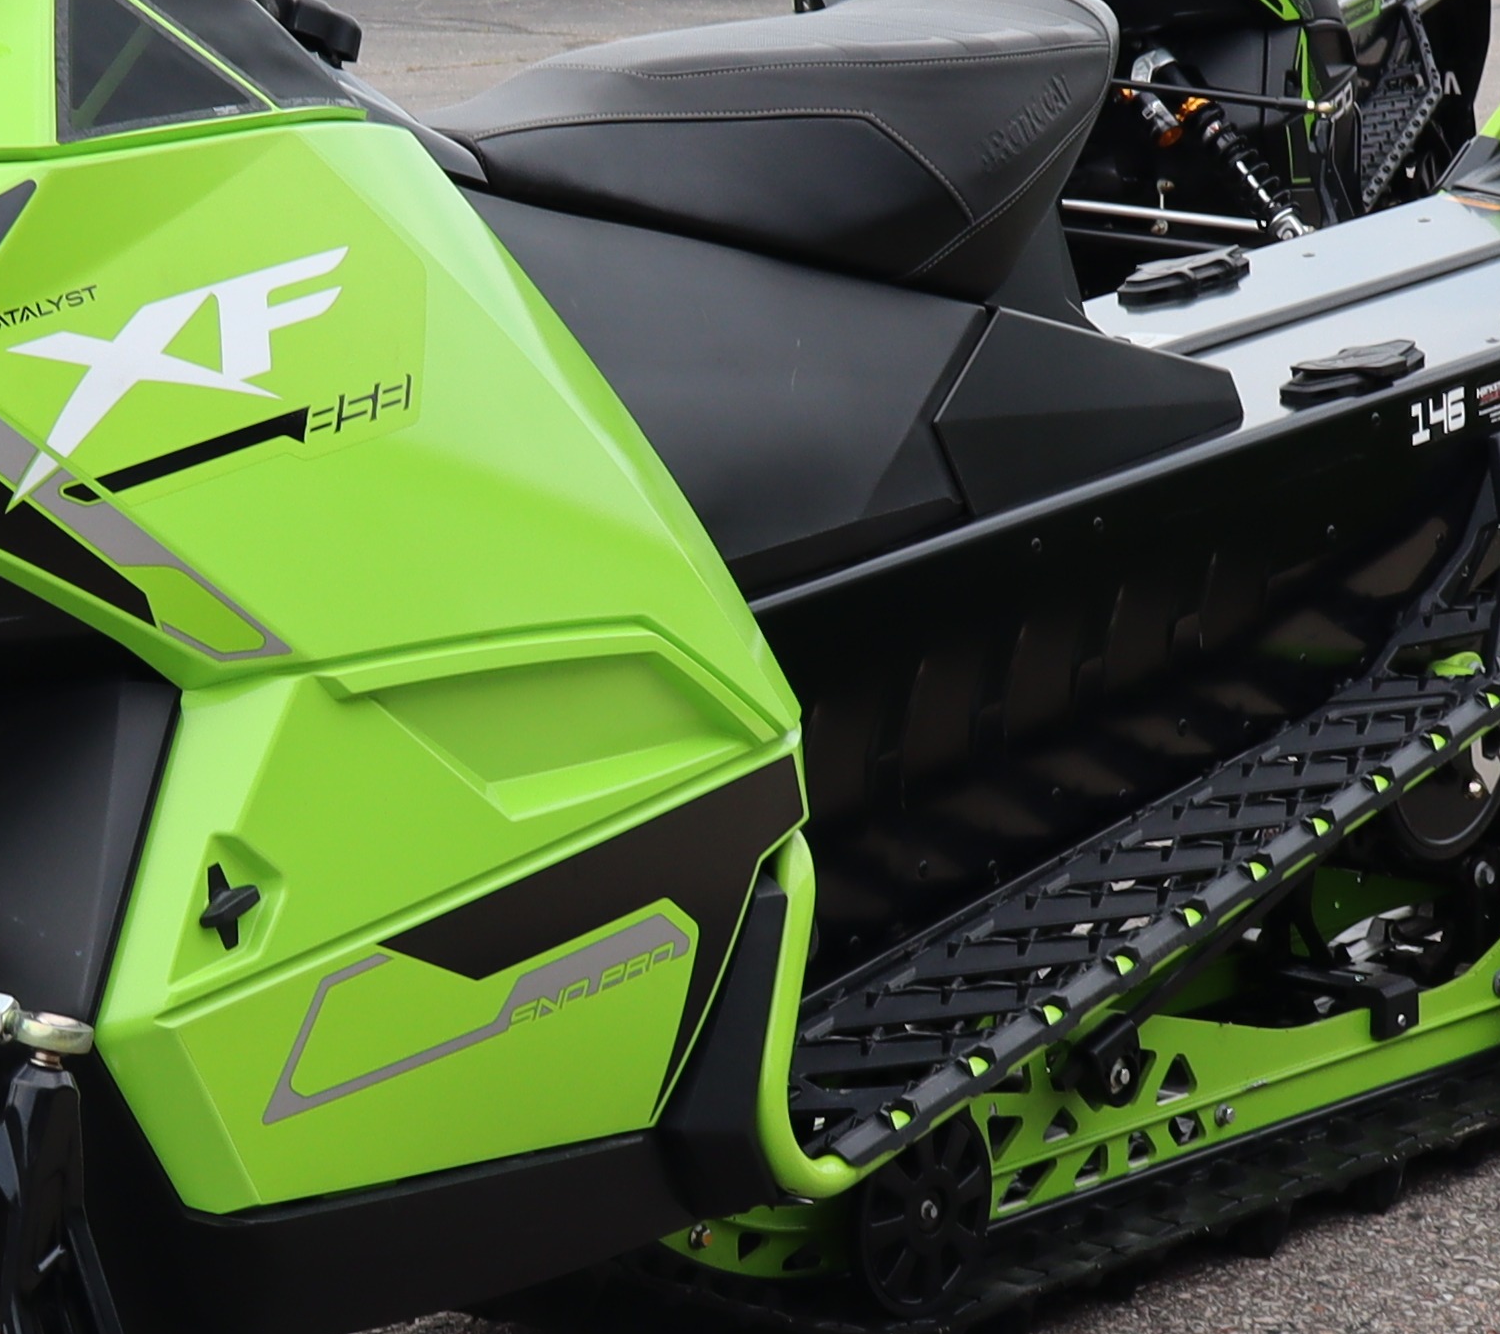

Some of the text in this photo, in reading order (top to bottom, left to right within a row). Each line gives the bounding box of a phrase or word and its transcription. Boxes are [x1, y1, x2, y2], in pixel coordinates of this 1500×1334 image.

[4, 245, 351, 515] XF
[1411, 386, 1466, 447] 146
[509, 940, 676, 1027] SNO PRO
